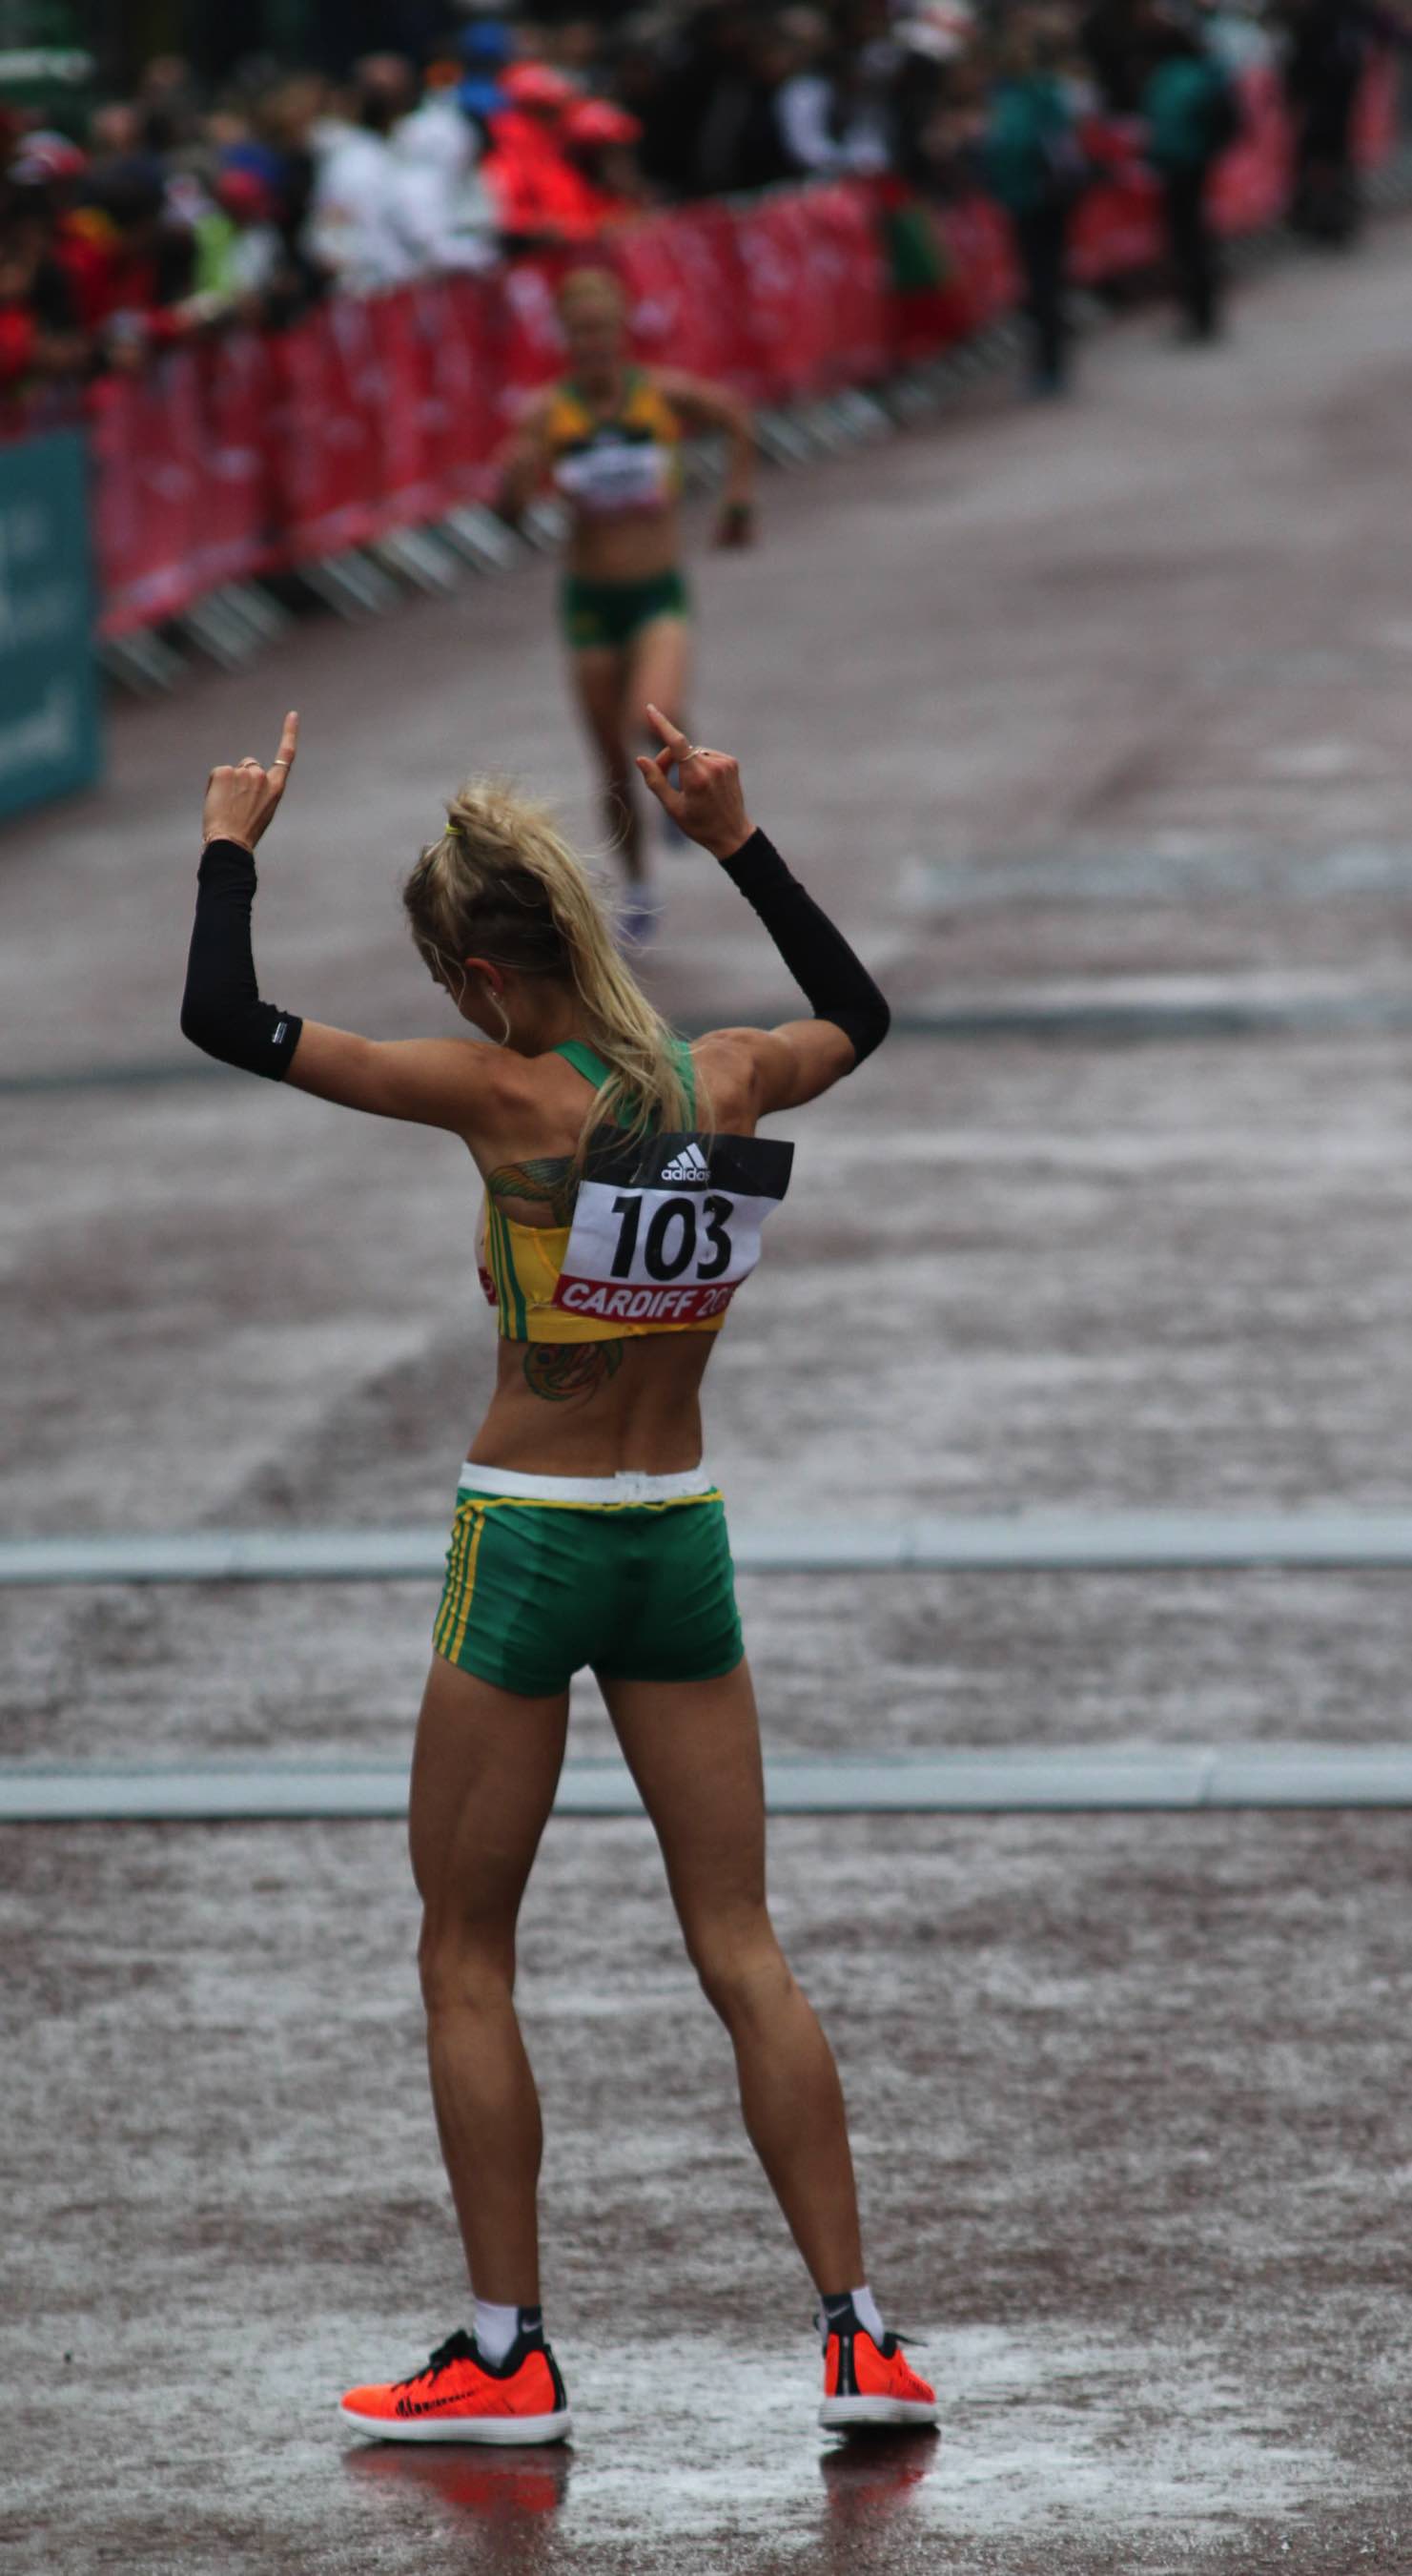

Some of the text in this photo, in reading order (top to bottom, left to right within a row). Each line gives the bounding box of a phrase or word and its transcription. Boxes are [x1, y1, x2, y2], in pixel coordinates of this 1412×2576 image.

[661, 1166, 711, 1182] adidas
[610, 1194, 734, 1282] 103
[562, 1282, 731, 1318] CARDIFF 20
